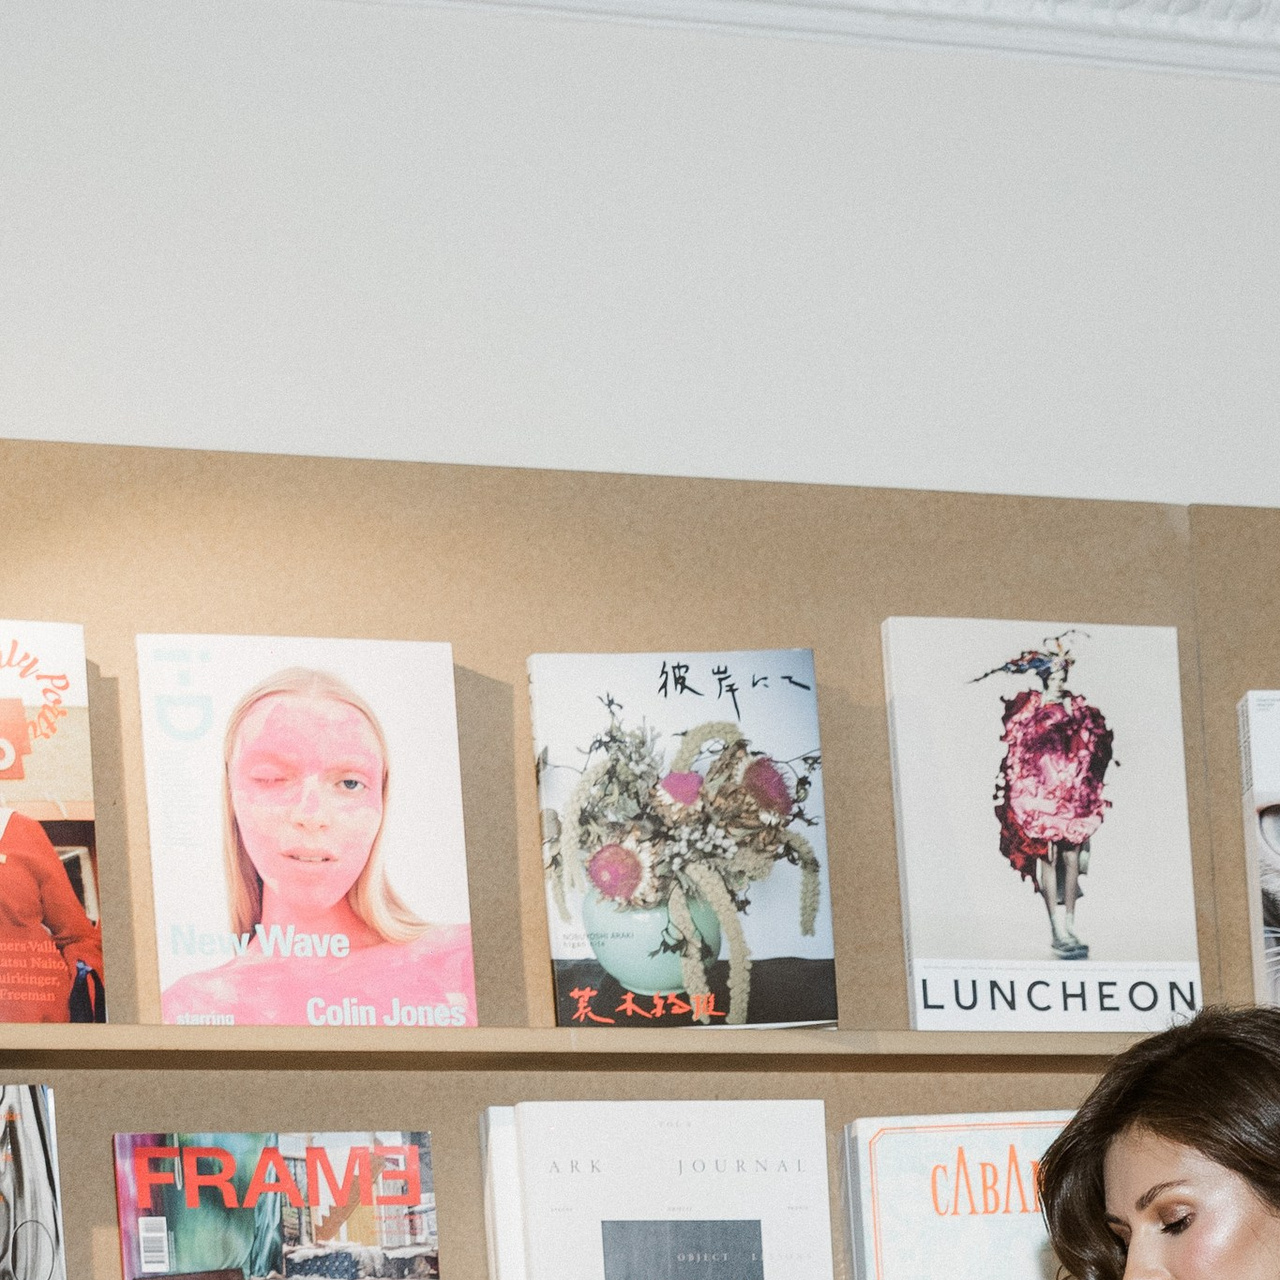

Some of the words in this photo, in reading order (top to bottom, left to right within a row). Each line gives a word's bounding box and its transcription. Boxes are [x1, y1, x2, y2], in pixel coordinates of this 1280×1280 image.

[171, 924, 250, 957] New
[255, 923, 350, 958] Wave
[306, 996, 376, 1026] Colin
[383, 997, 467, 1026] Jones
[922, 978, 1197, 1012] LUNCHEON
[549, 1159, 603, 1174] ARK
[678, 1158, 807, 1176] JOURNAL
